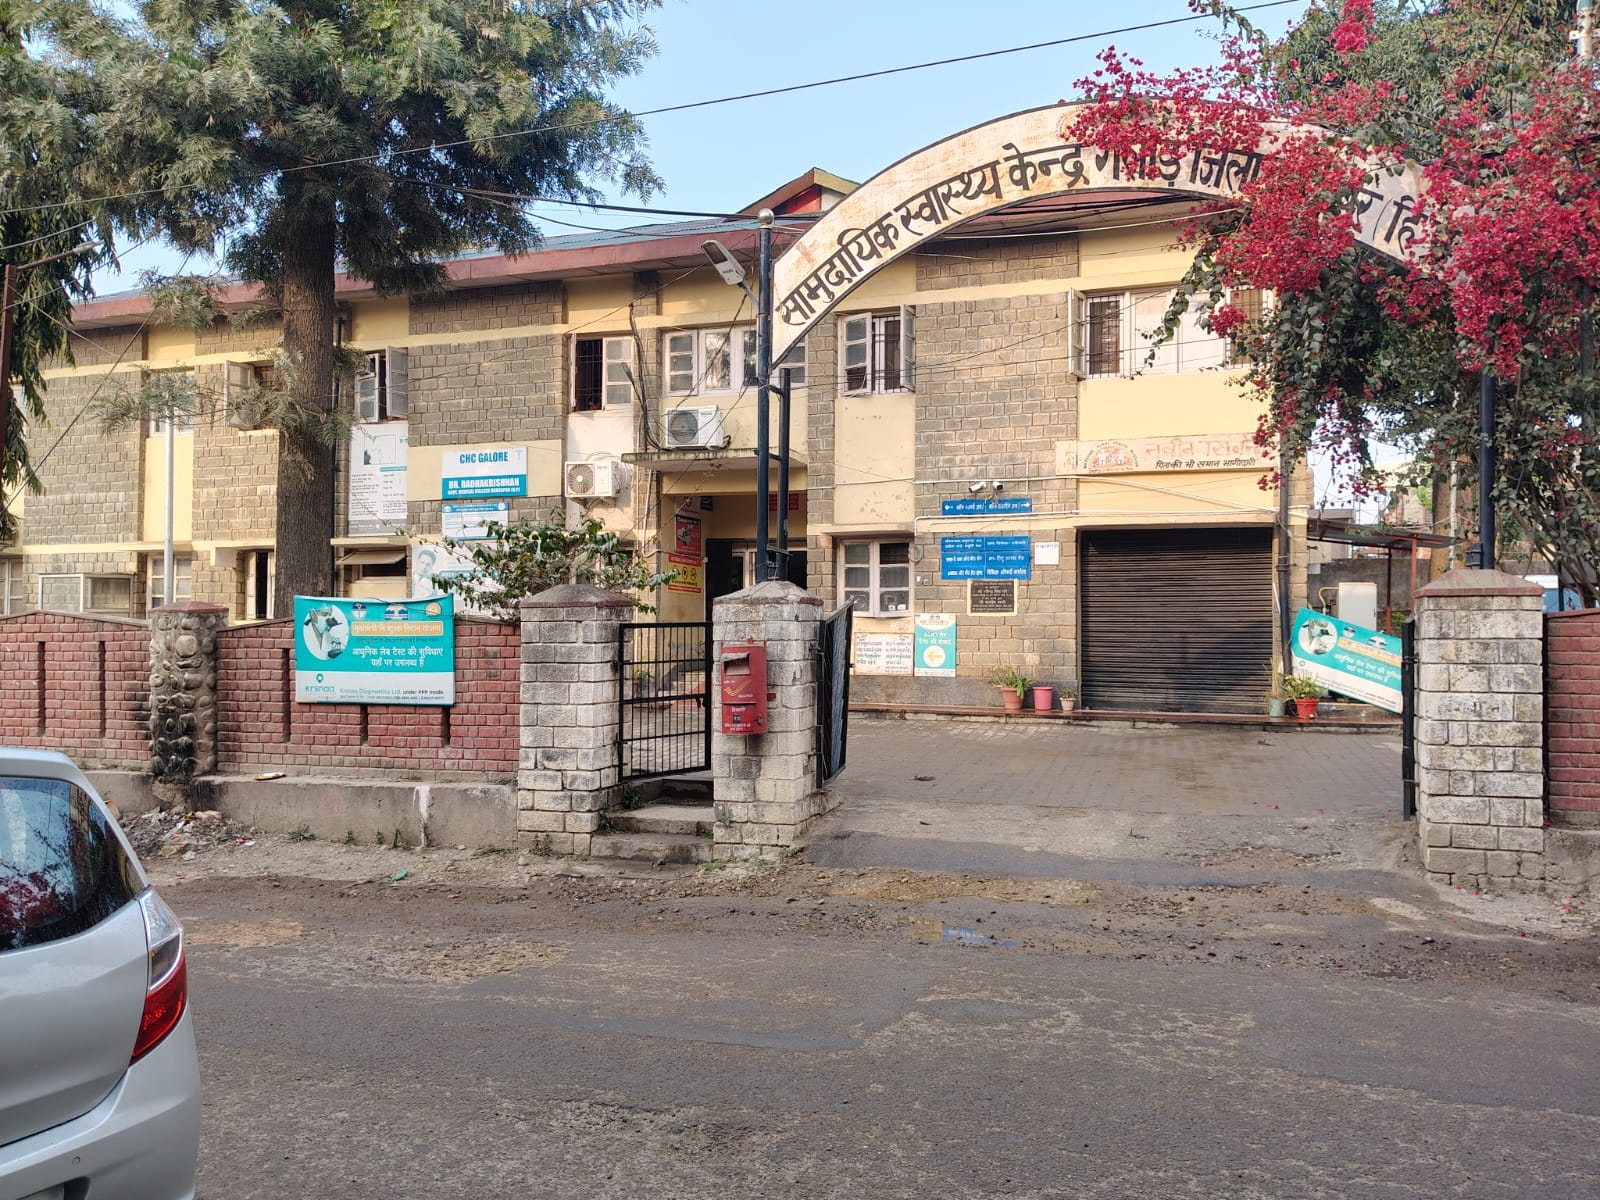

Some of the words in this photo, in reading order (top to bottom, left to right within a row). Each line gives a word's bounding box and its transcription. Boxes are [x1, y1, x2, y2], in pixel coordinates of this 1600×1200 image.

[775, 211, 899, 326] सामुदायिक
[893, 160, 1003, 236] स्वास्थ्य
[1002, 142, 1090, 190] केन्द्र
[459, 453, 476, 464] CHC
[478, 451, 508, 463] GALORE
[408, 645, 417, 656] की
[383, 658, 393, 667] पर
